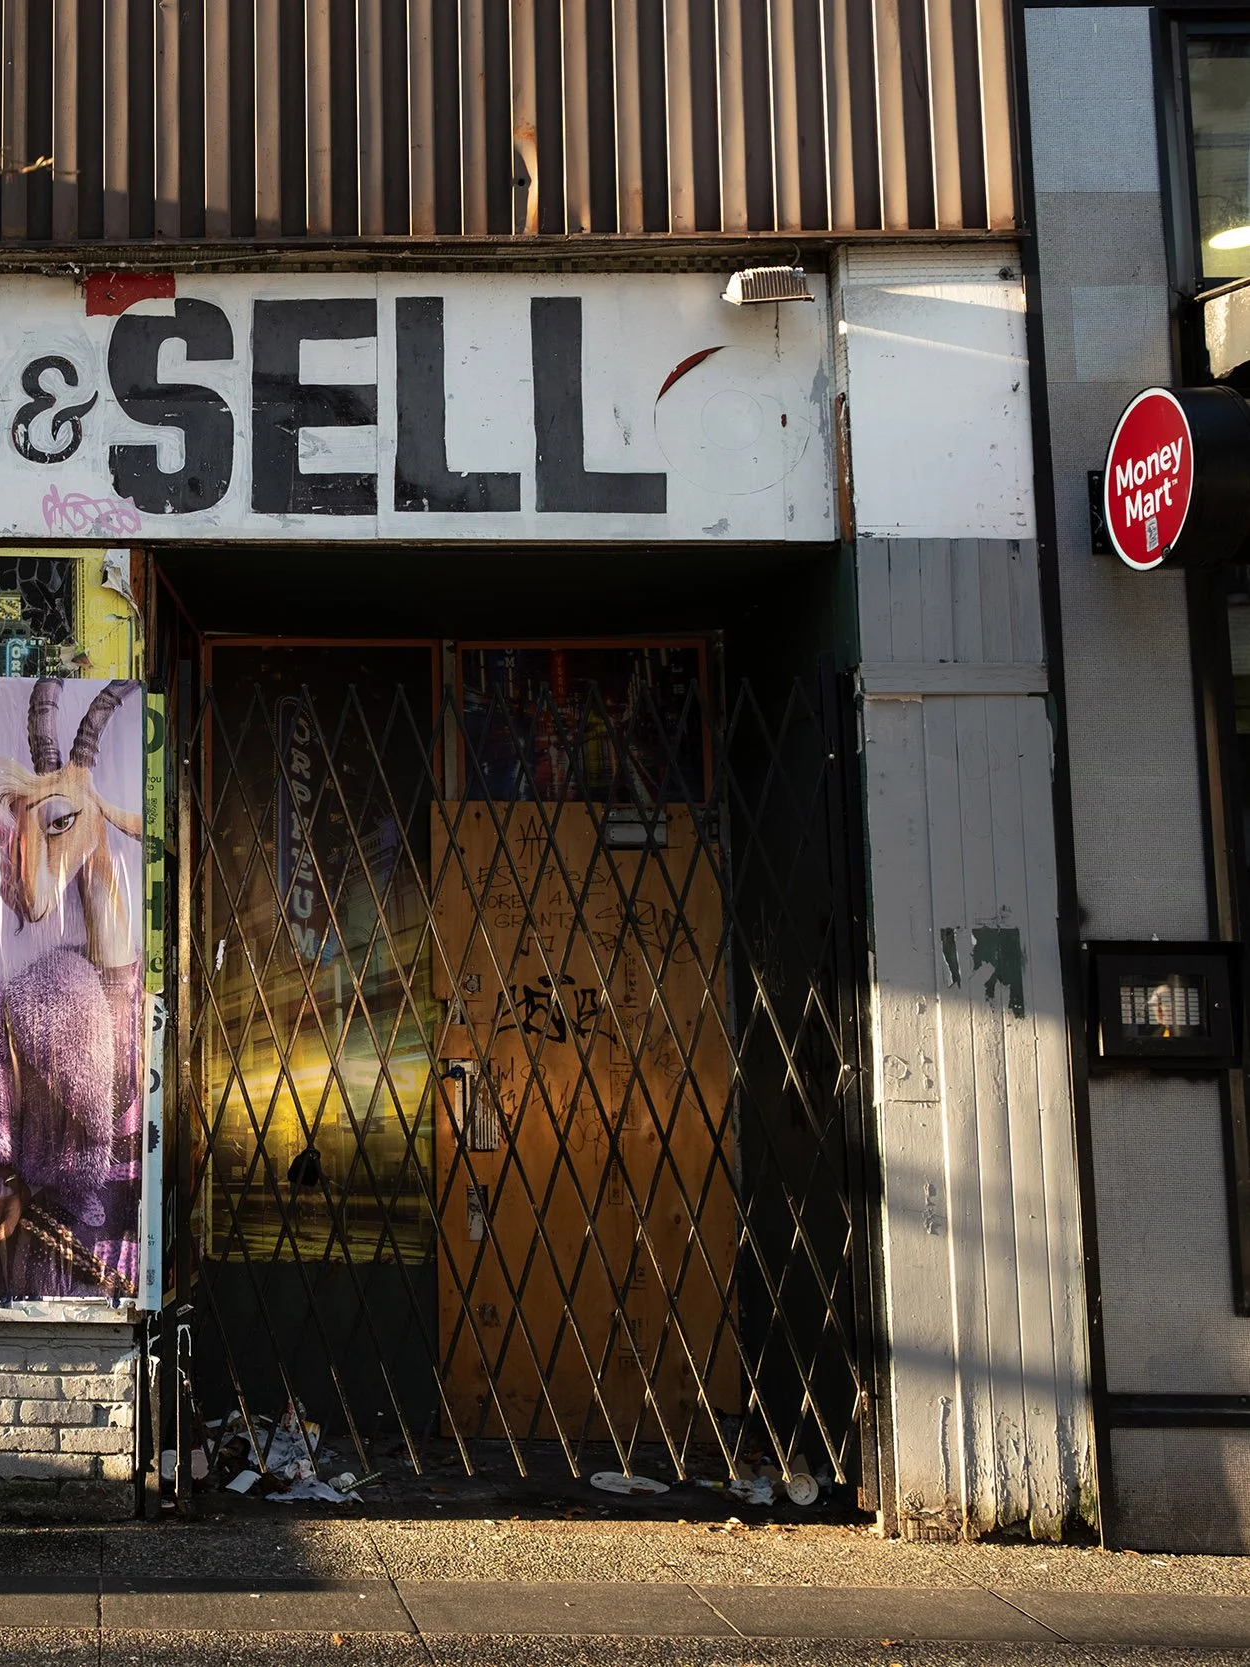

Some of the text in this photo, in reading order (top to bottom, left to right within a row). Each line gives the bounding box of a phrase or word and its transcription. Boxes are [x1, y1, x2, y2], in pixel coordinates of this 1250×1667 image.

[10, 354, 98, 464] &
[108, 297, 666, 515] SELL
[1116, 437, 1183, 496] Money
[1125, 477, 1173, 527] Mart
[470, 893, 527, 913] ORE
[494, 913, 576, 929] GRNTS
